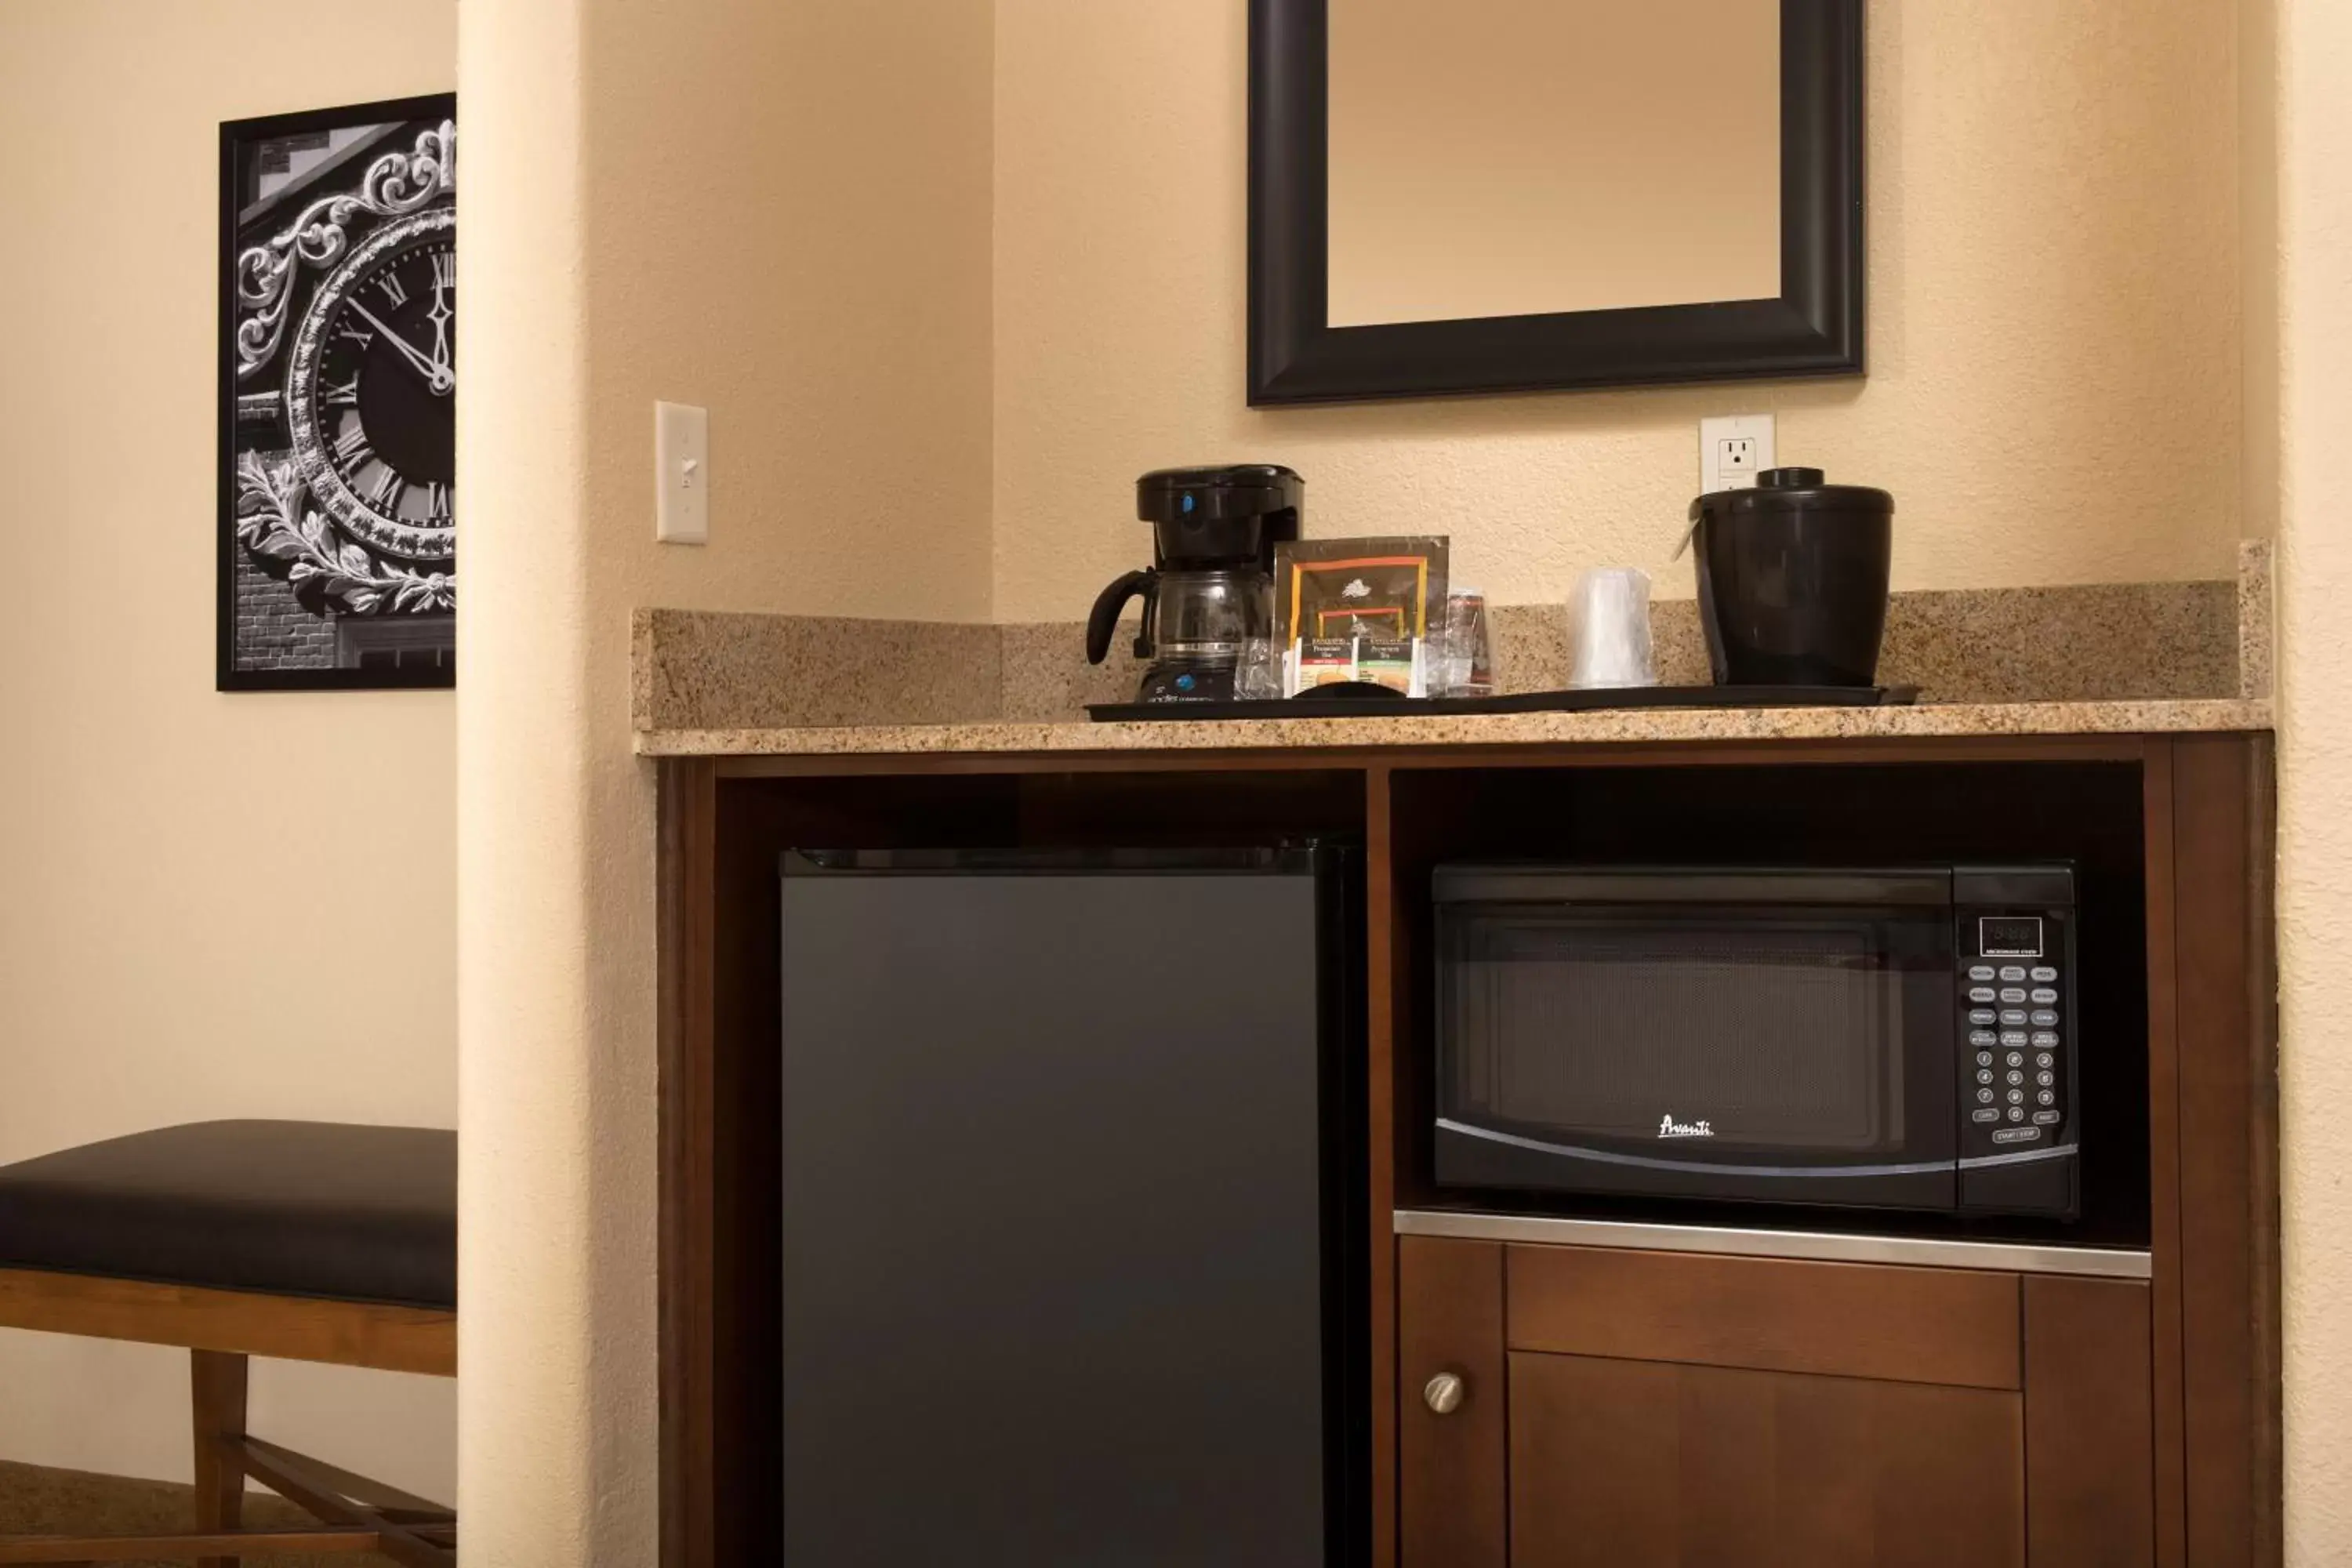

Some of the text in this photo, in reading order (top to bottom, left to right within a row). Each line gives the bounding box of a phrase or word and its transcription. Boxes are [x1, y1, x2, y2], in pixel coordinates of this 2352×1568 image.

[377, 273, 409, 310] XI
[339, 320, 373, 351] X
[1657, 1114, 1715, 1138] Avanti
